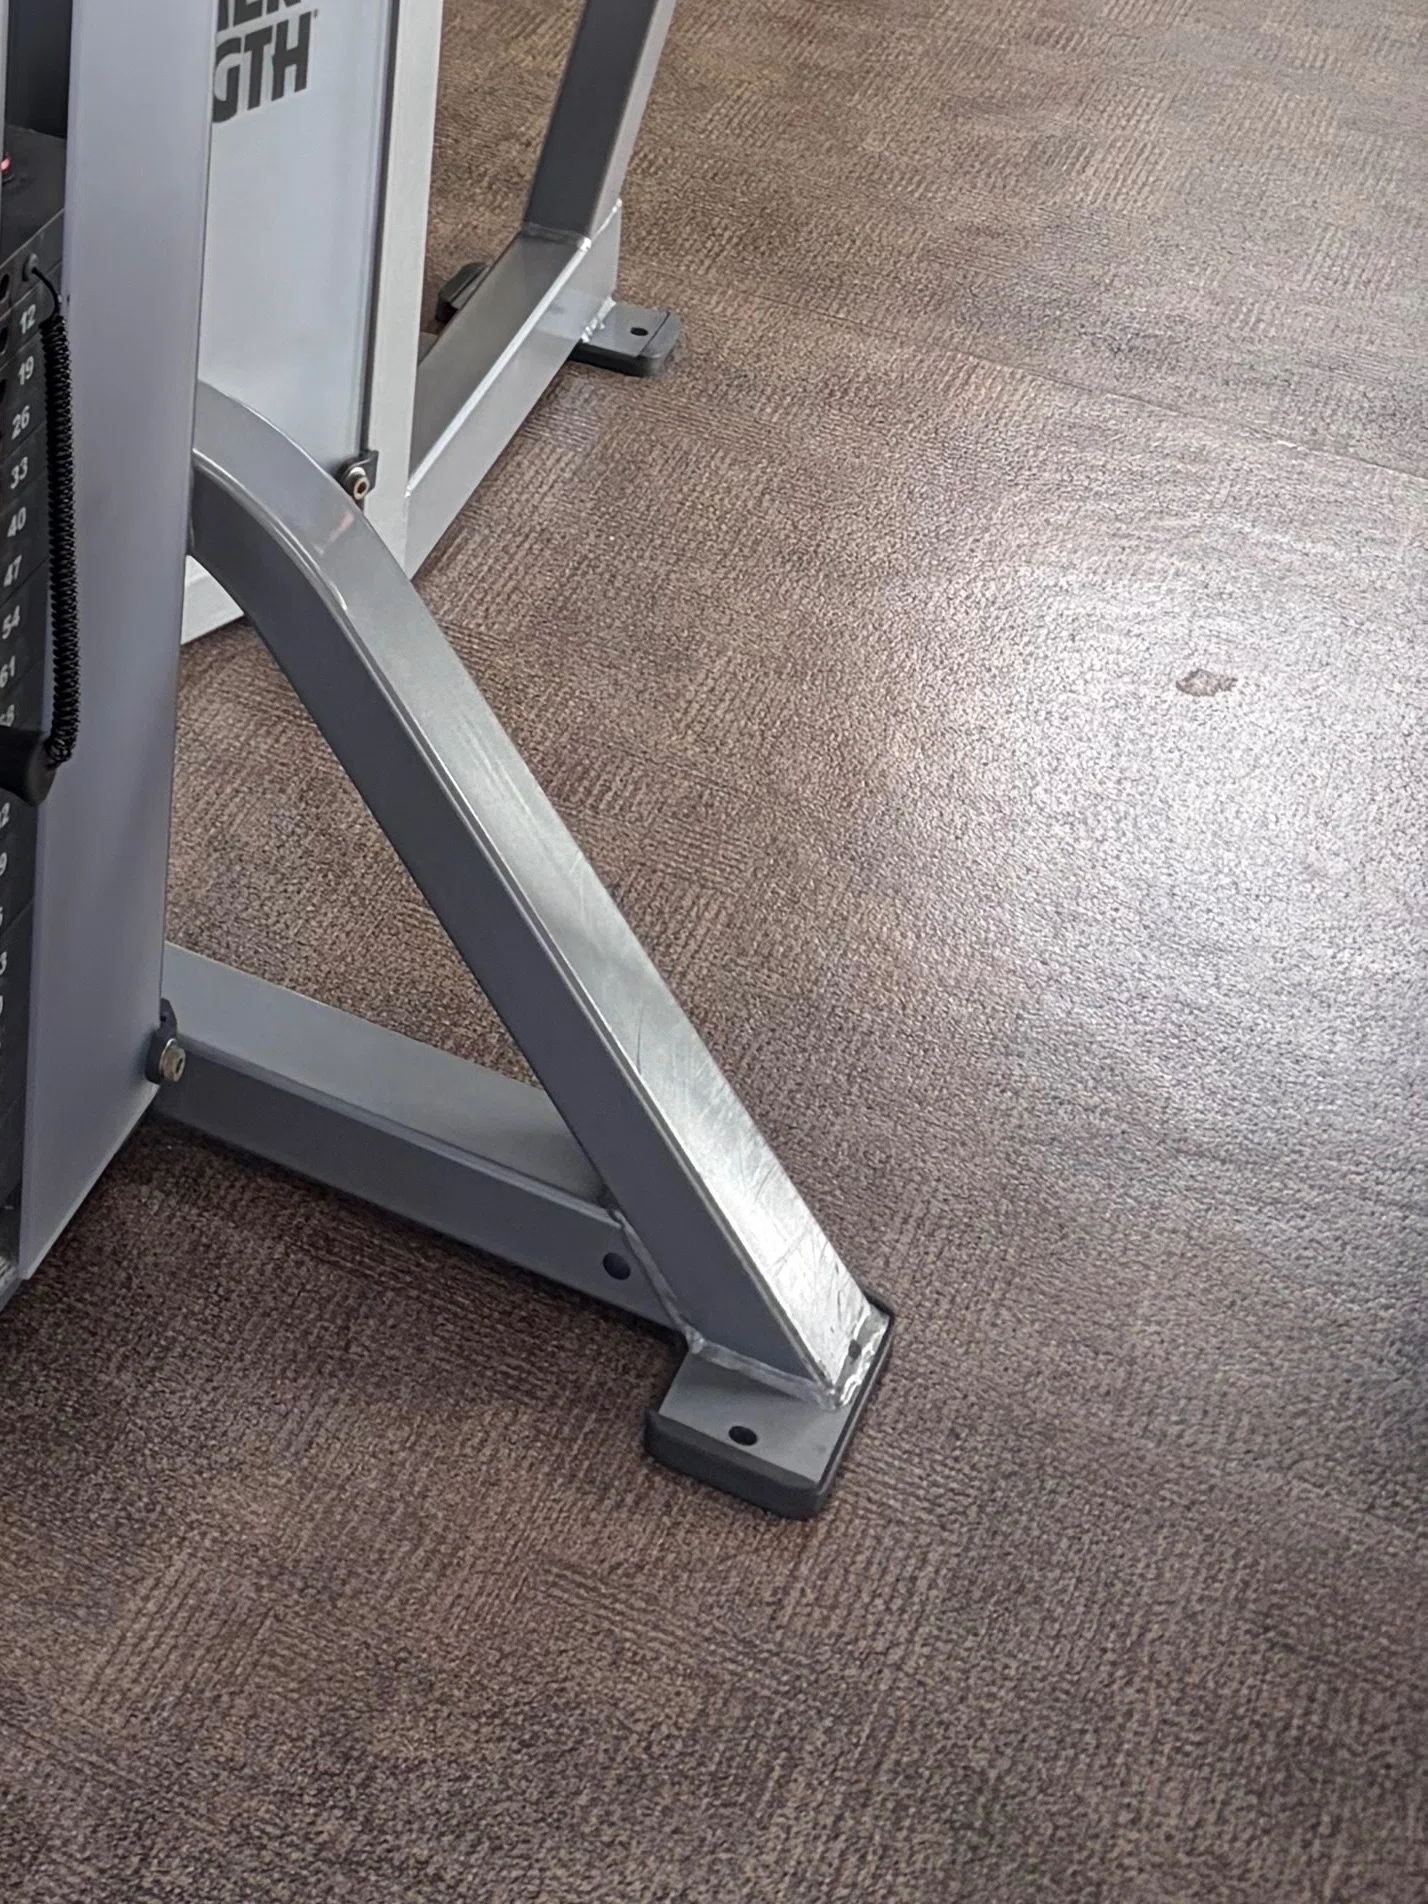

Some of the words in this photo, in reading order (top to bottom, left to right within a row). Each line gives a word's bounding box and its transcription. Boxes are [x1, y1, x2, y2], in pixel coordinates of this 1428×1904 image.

[212, 11, 312, 123] GTH
[19, 303, 37, 334] 12
[17, 355, 35, 386] 19
[11, 405, 30, 440] 26
[10, 456, 28, 489] 33
[7, 506, 27, 538] 40
[4, 554, 22, 588] 47
[2, 604, 21, 640] 54
